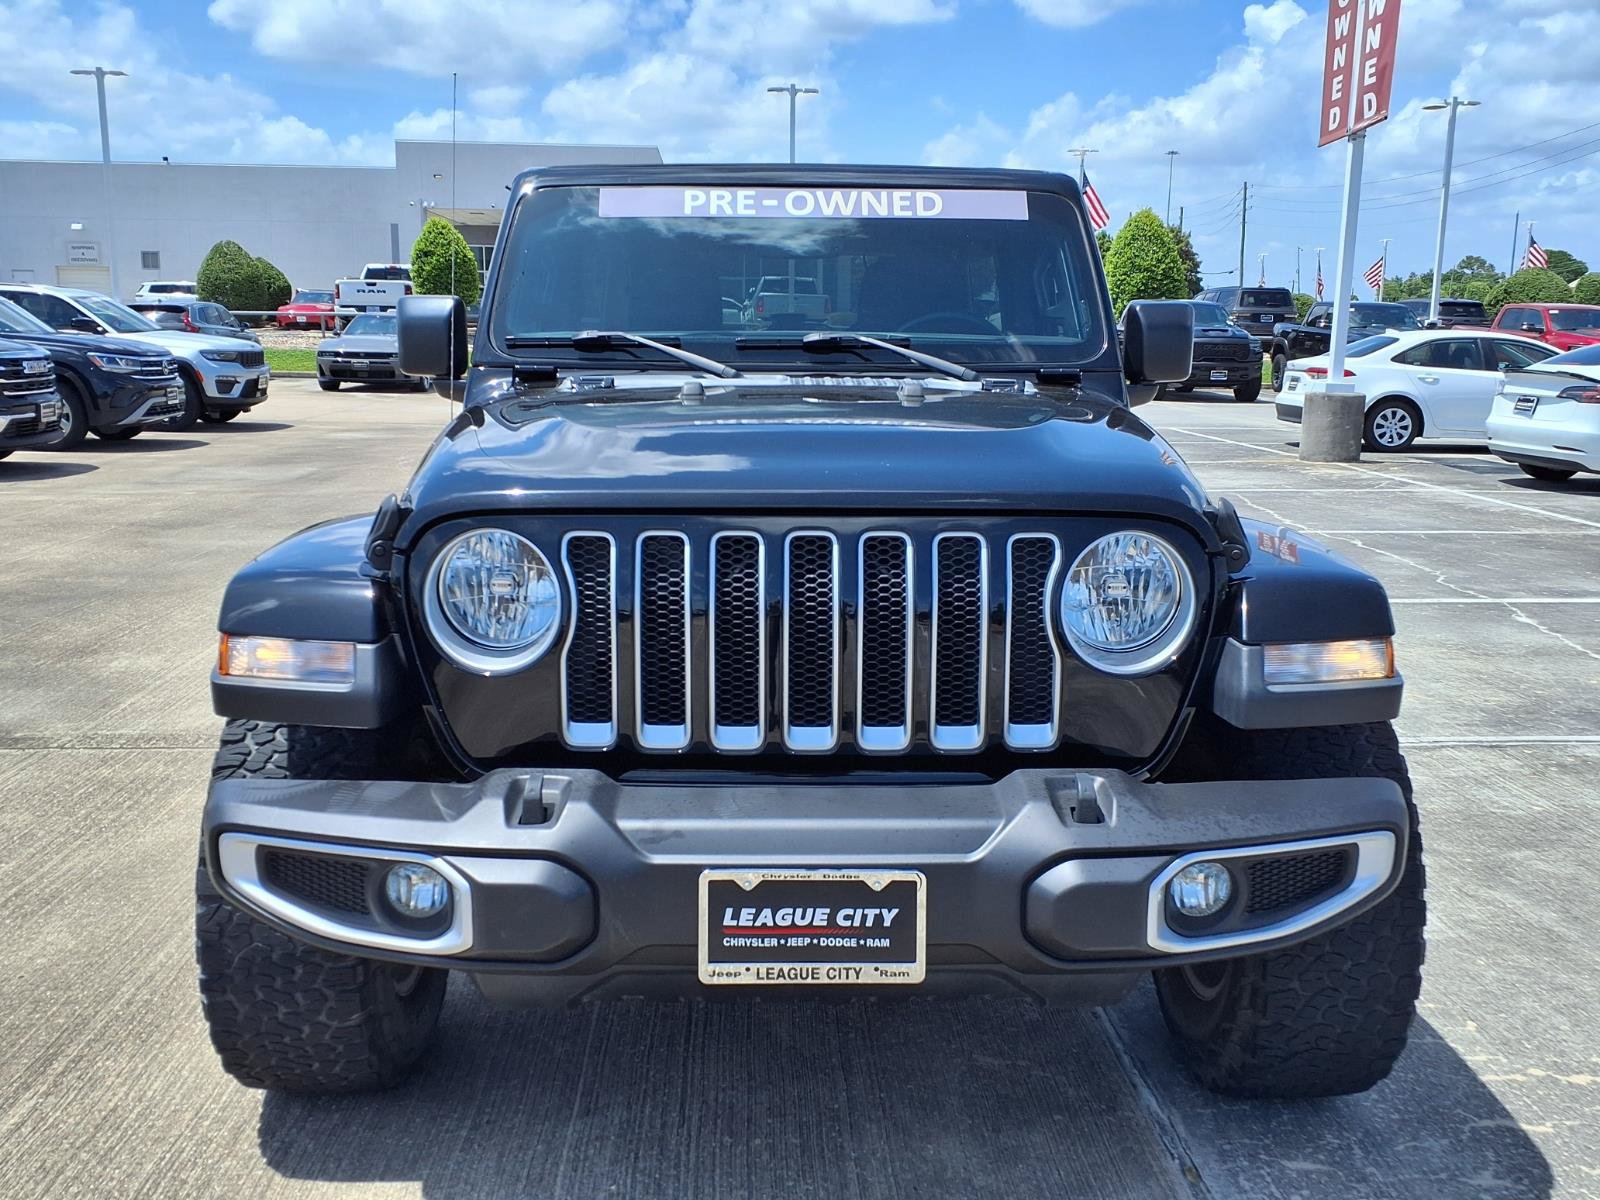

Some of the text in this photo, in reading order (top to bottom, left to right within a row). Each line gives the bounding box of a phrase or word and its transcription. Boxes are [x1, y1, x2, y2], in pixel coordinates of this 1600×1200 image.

[1329, 0, 1351, 131] WNED
[683, 190, 943, 216] PRE-OWNED
[723, 908, 899, 927] LEAGUE CITY
[723, 937, 890, 947] CHRYSLER JEEP DODGE RAM
[708, 967, 910, 980] Jeep LEAGUE CITY Ram
